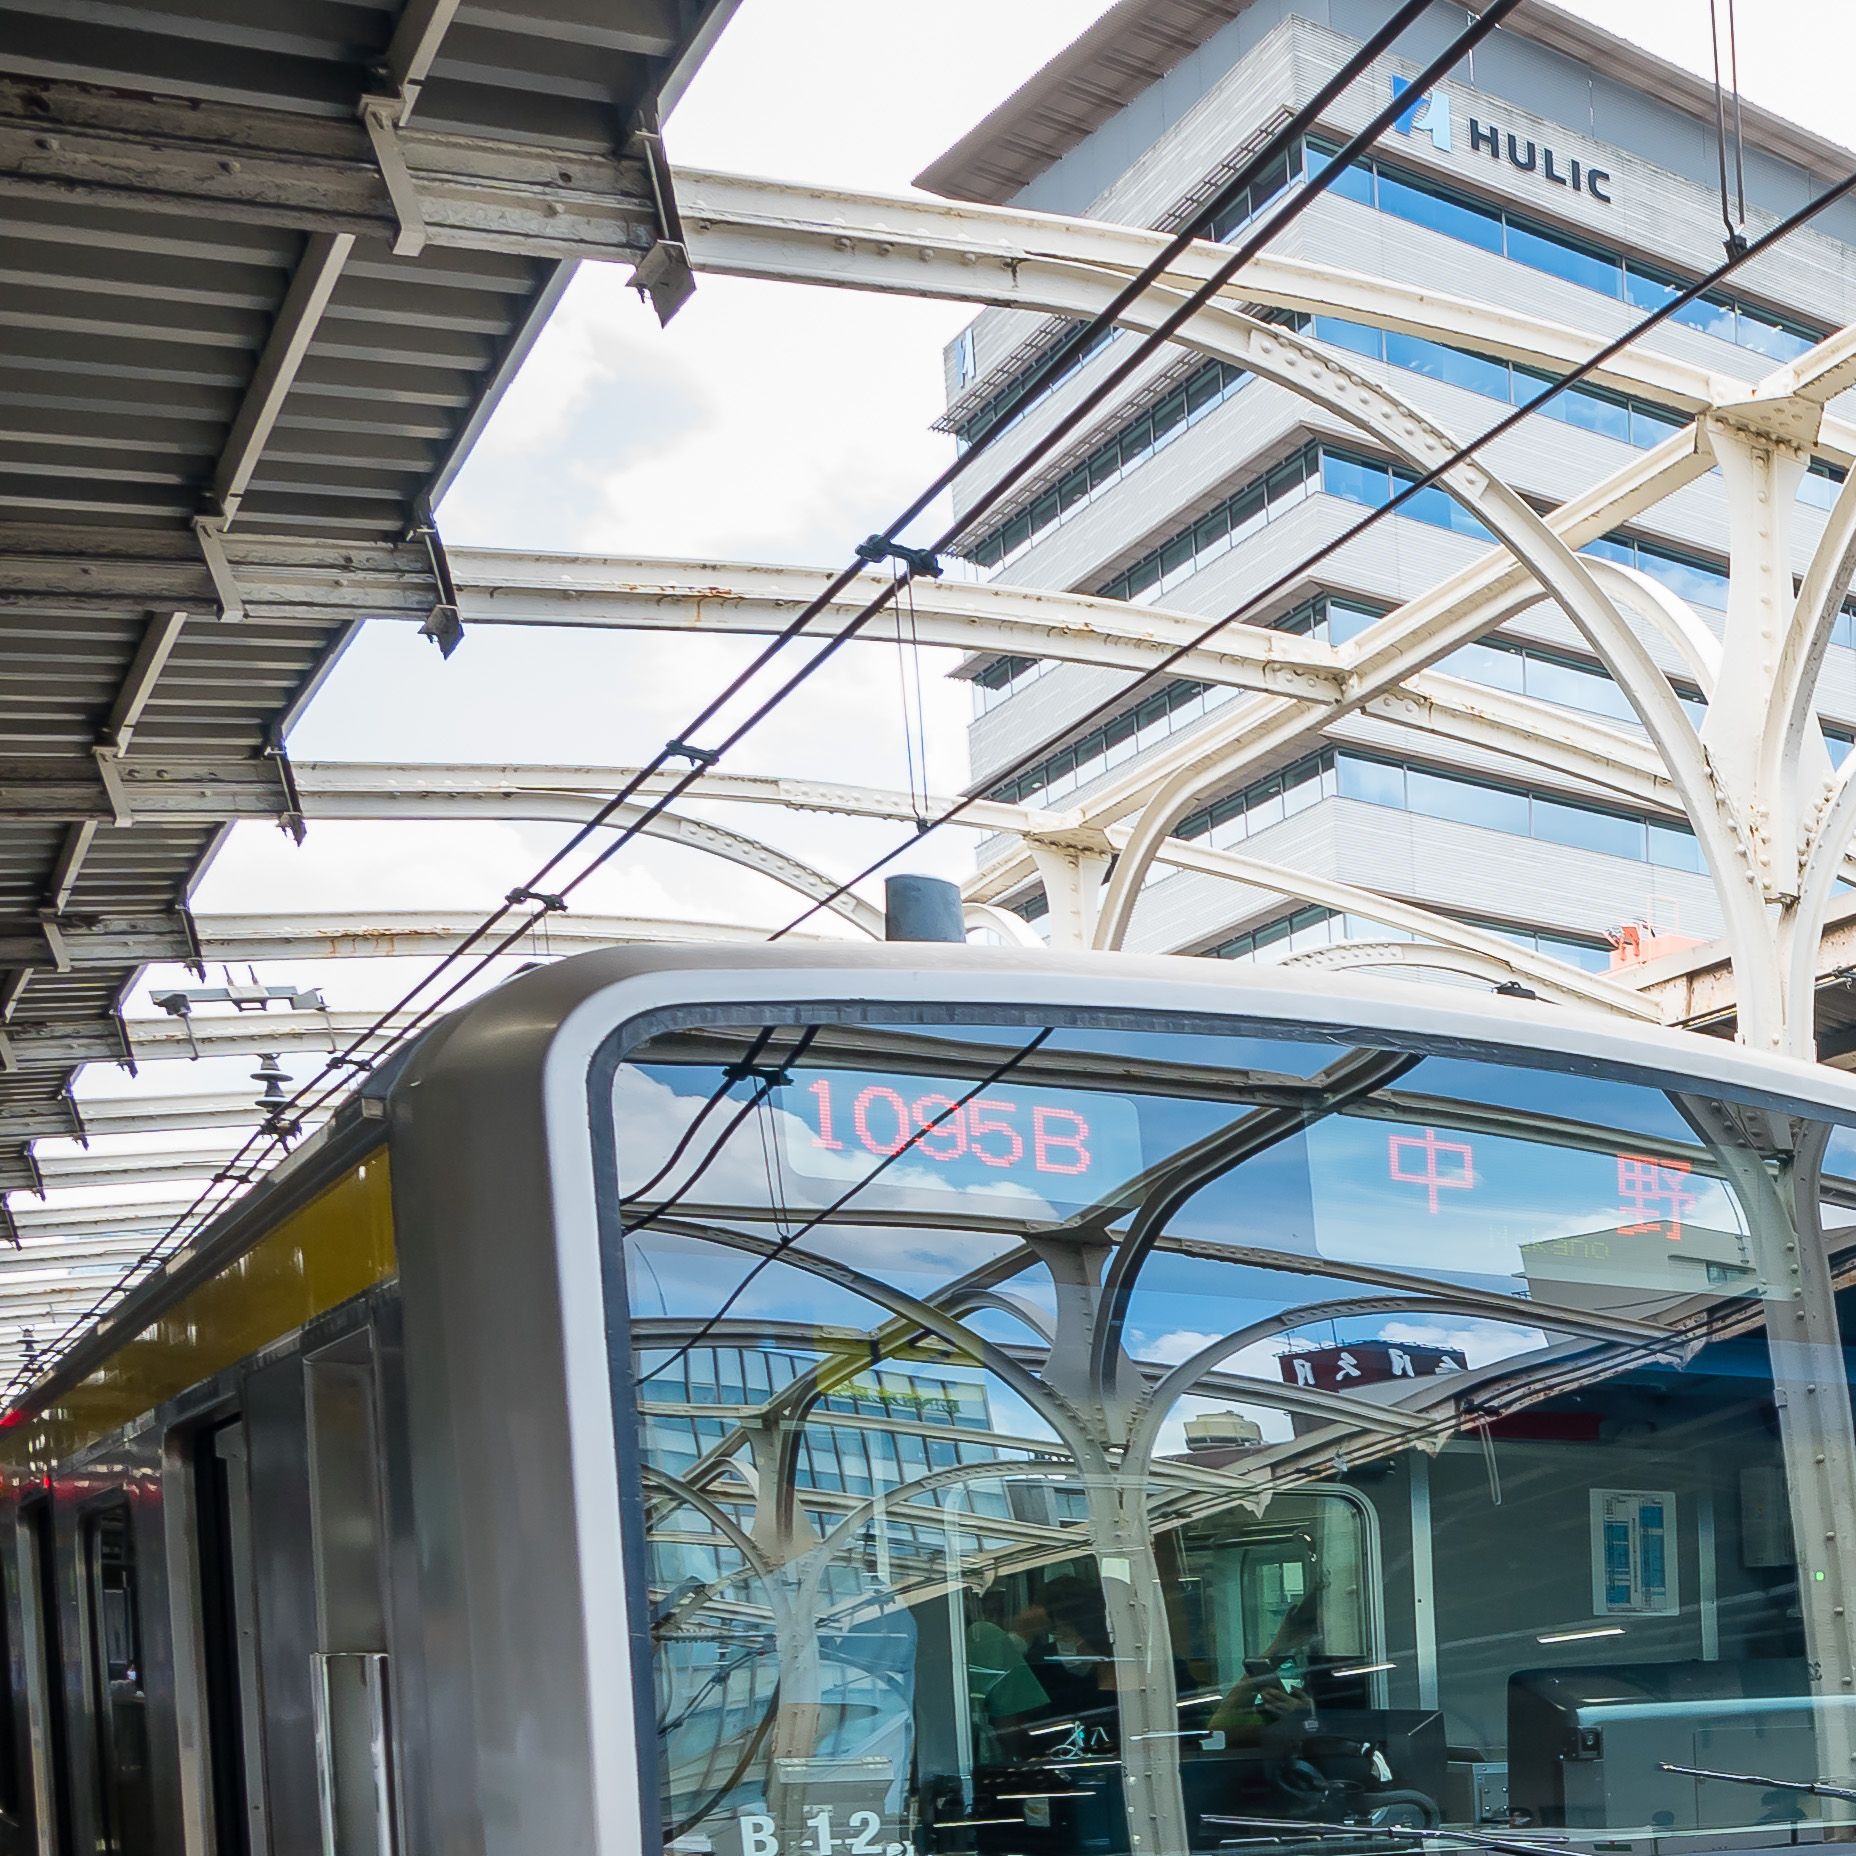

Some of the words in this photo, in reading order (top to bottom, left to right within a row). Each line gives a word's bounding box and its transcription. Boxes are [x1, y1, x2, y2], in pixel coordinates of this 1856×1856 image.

[1469, 117, 1611, 204] HULIC
[808, 1079, 1091, 1174] 1095B
[807, 1810, 883, 1856] 12
